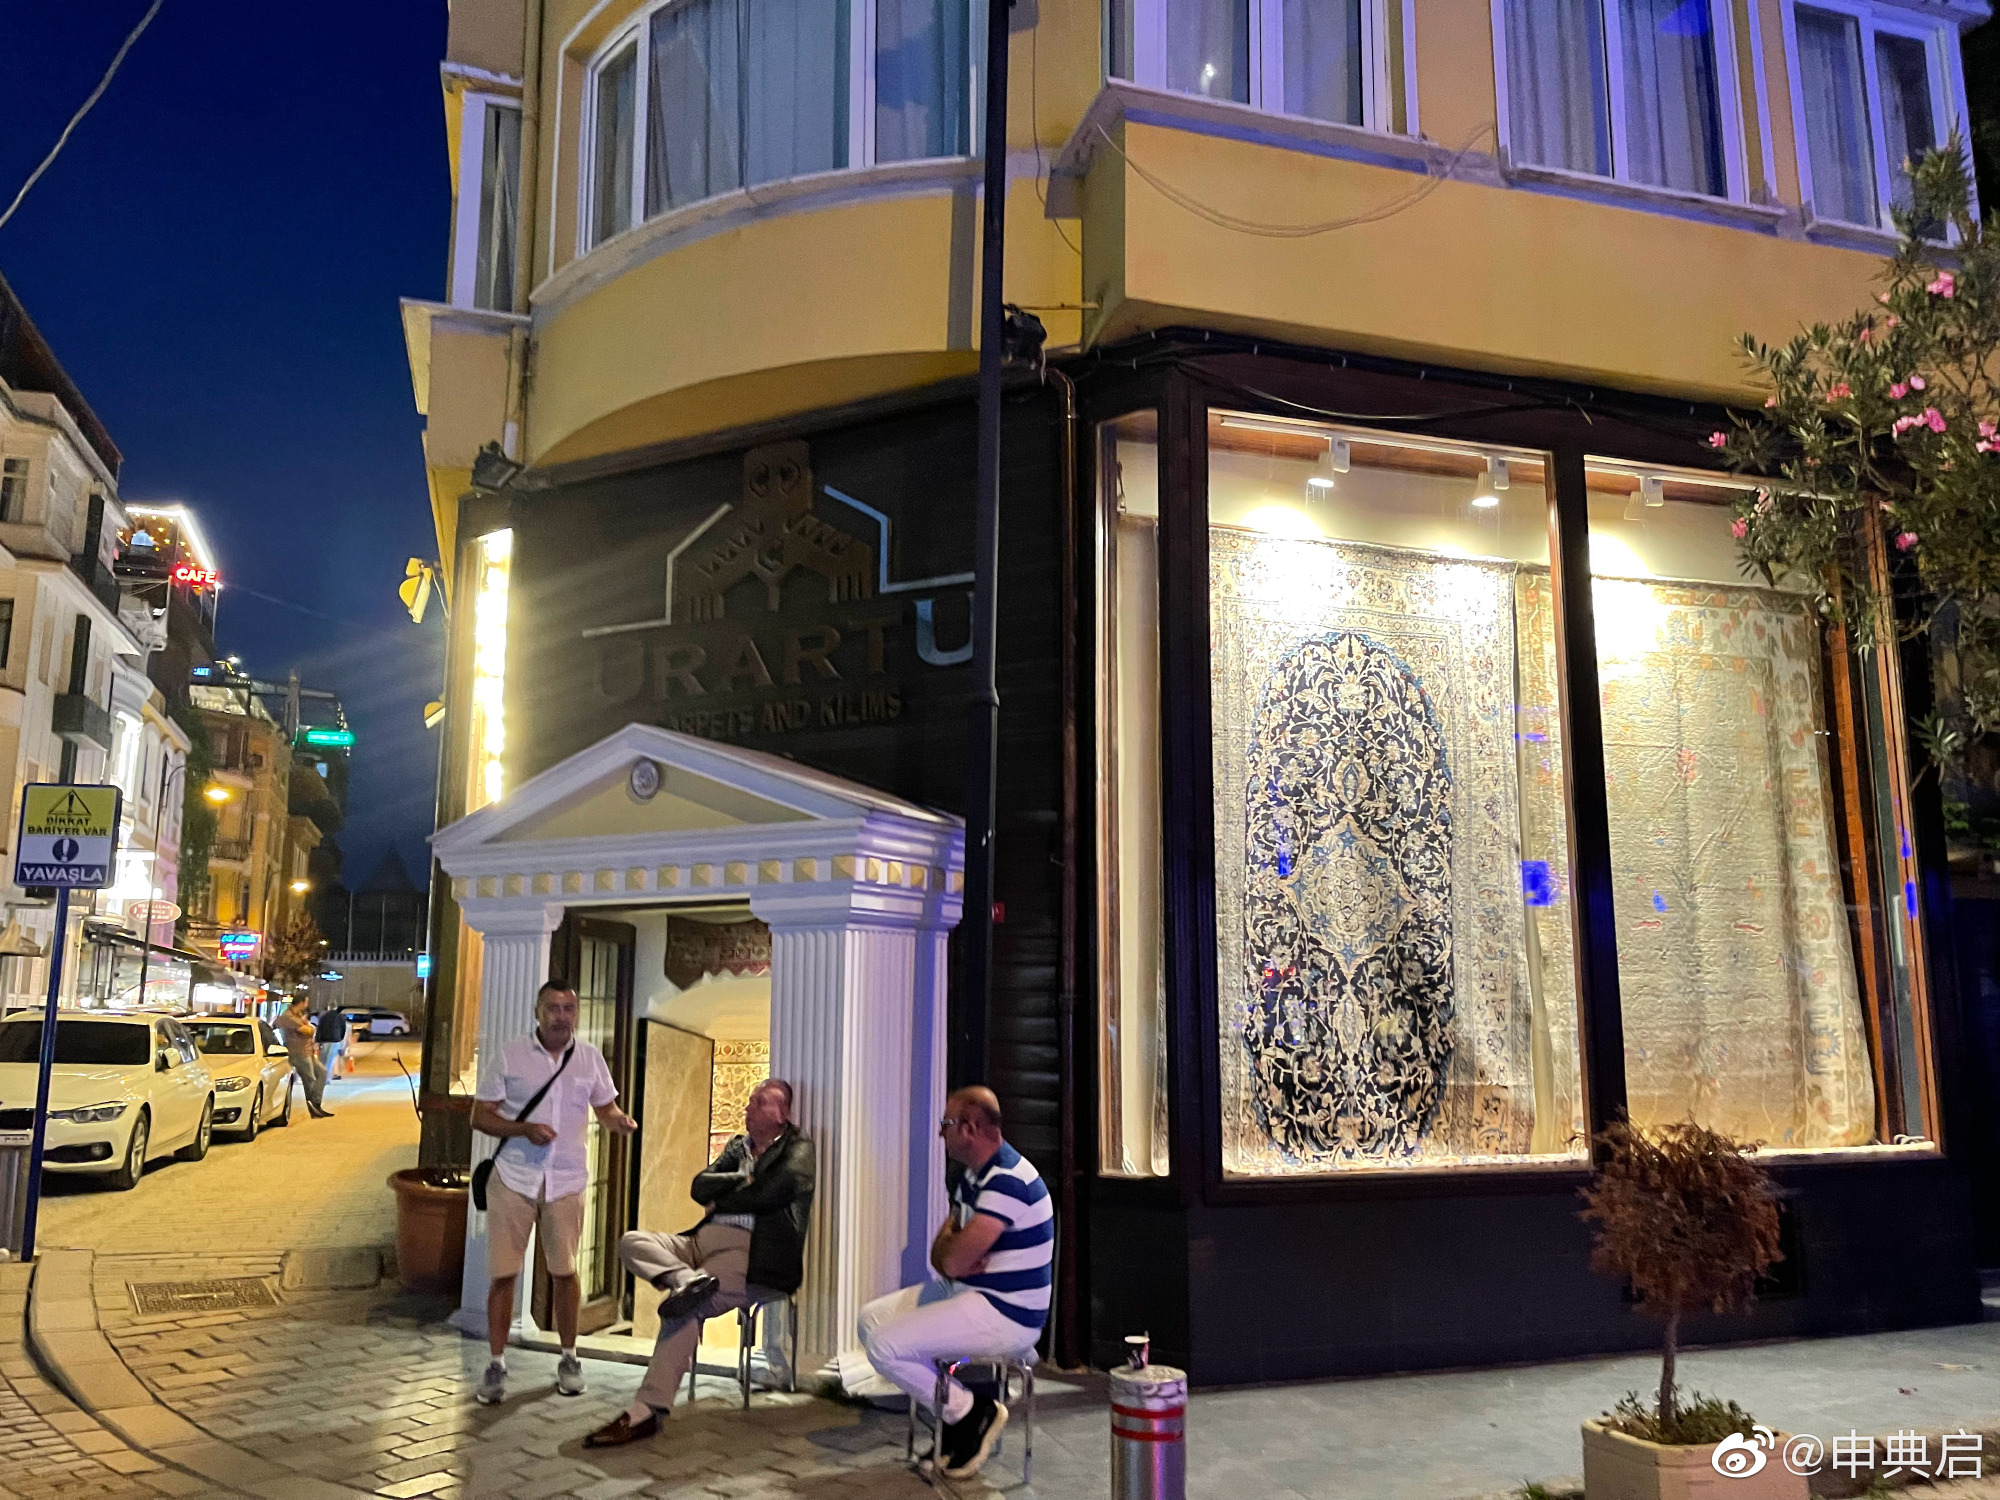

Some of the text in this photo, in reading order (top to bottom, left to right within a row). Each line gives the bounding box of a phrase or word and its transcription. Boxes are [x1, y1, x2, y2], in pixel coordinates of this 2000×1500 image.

[176, 568, 216, 584] CAFE
[588, 591, 975, 702] URARTU
[763, 698, 812, 734] AND
[820, 690, 902, 727] KILIMS
[84, 826, 107, 836] VAR
[22, 865, 103, 884] YAVAŞLA
